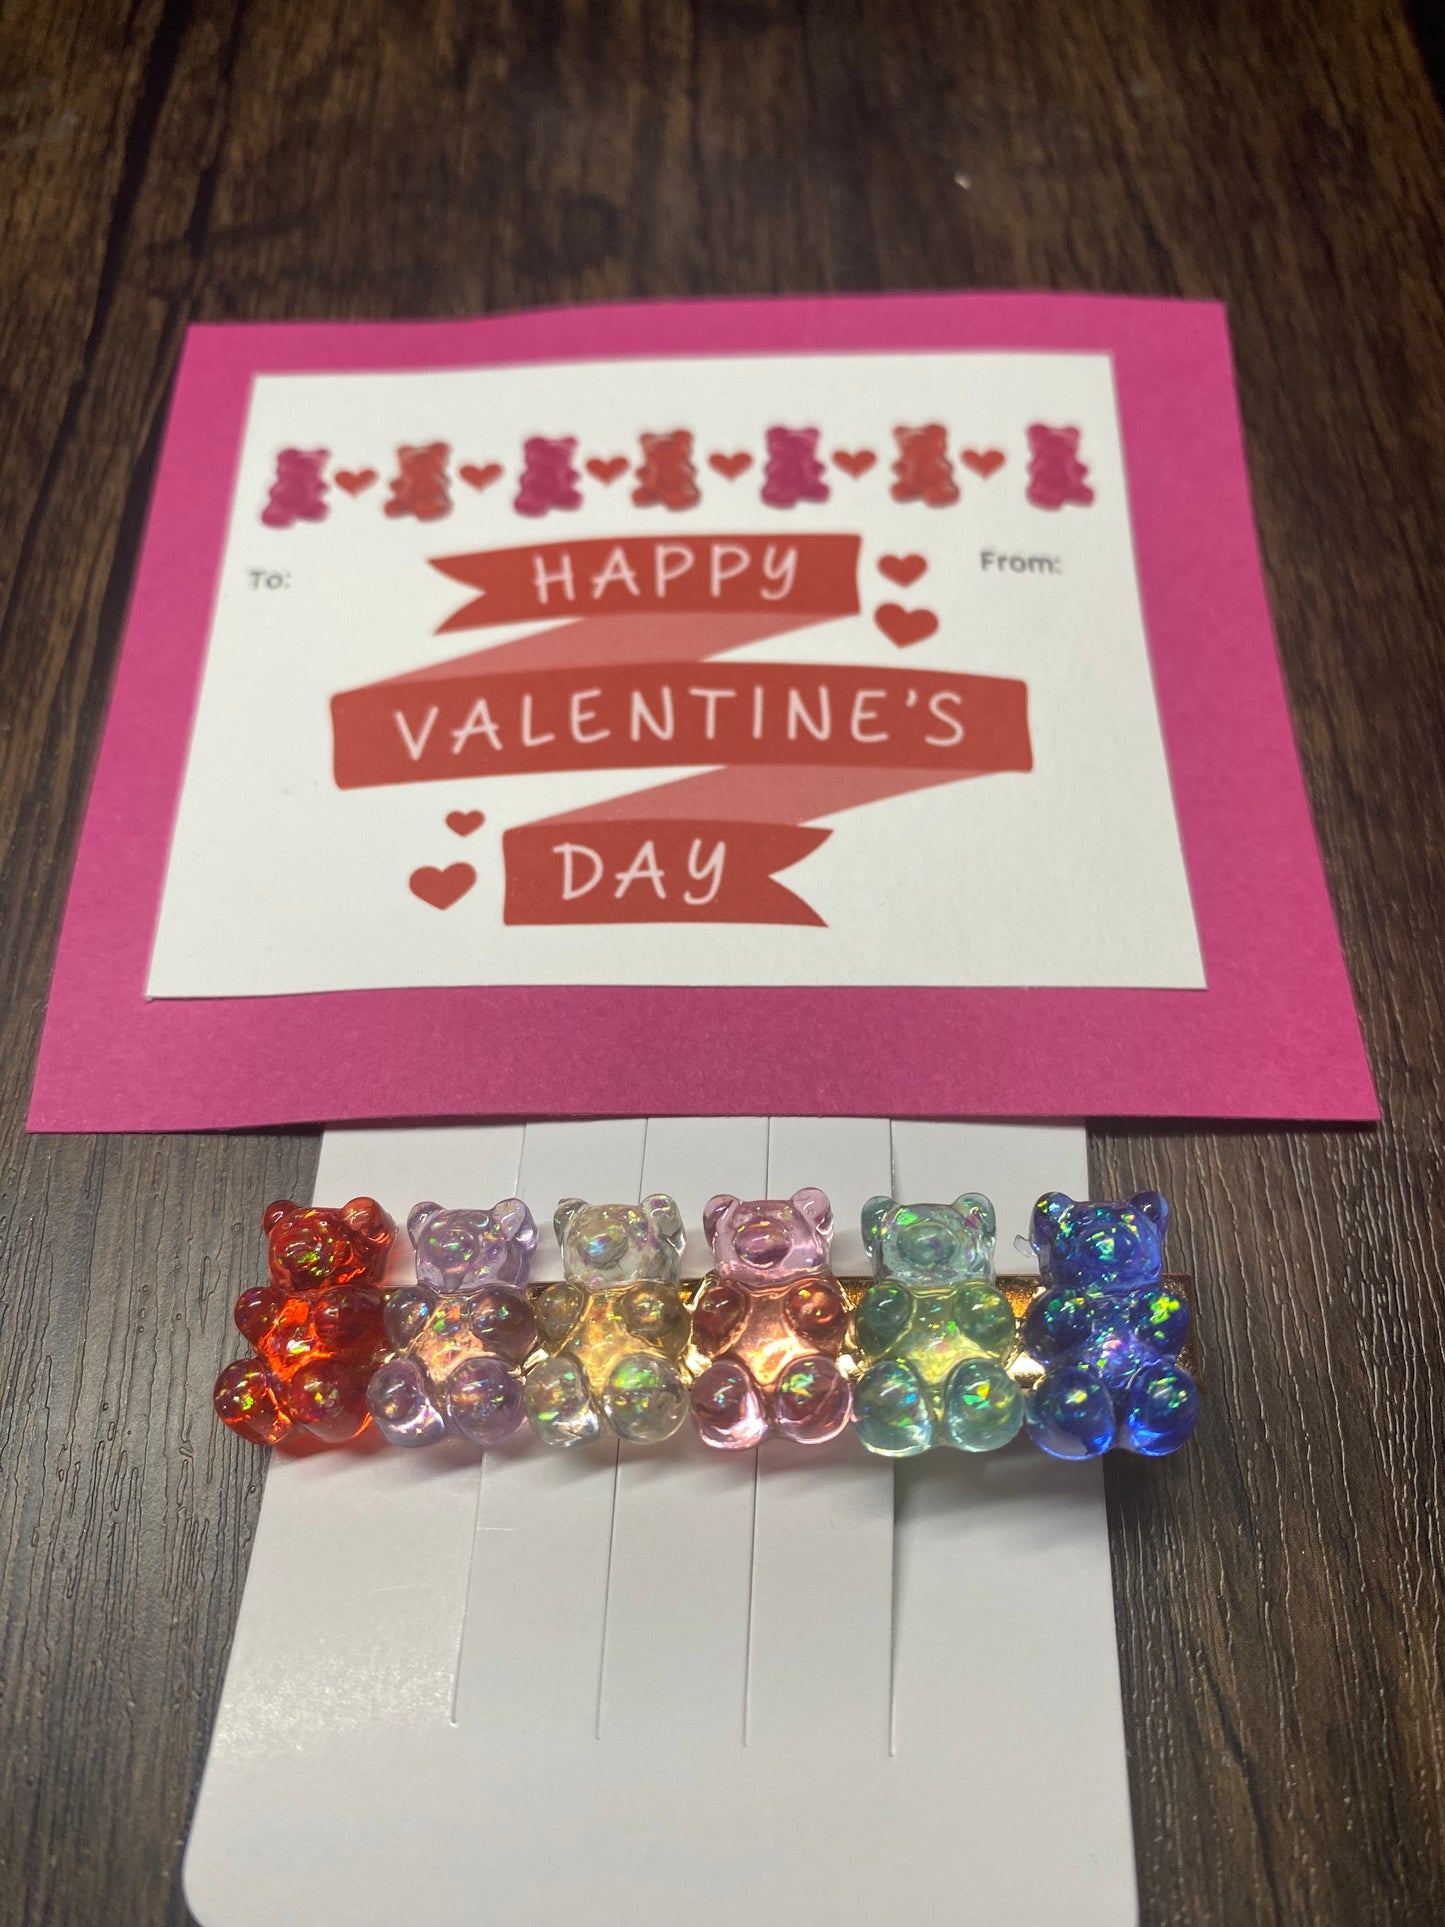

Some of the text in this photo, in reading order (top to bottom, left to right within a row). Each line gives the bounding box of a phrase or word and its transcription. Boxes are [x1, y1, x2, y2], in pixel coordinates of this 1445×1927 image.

[247, 569, 292, 591] To:
[532, 542, 799, 606] HAPPY
[979, 548, 1063, 575] From:
[393, 685, 966, 762] VALENTINE'S
[552, 837, 727, 907] DAY
